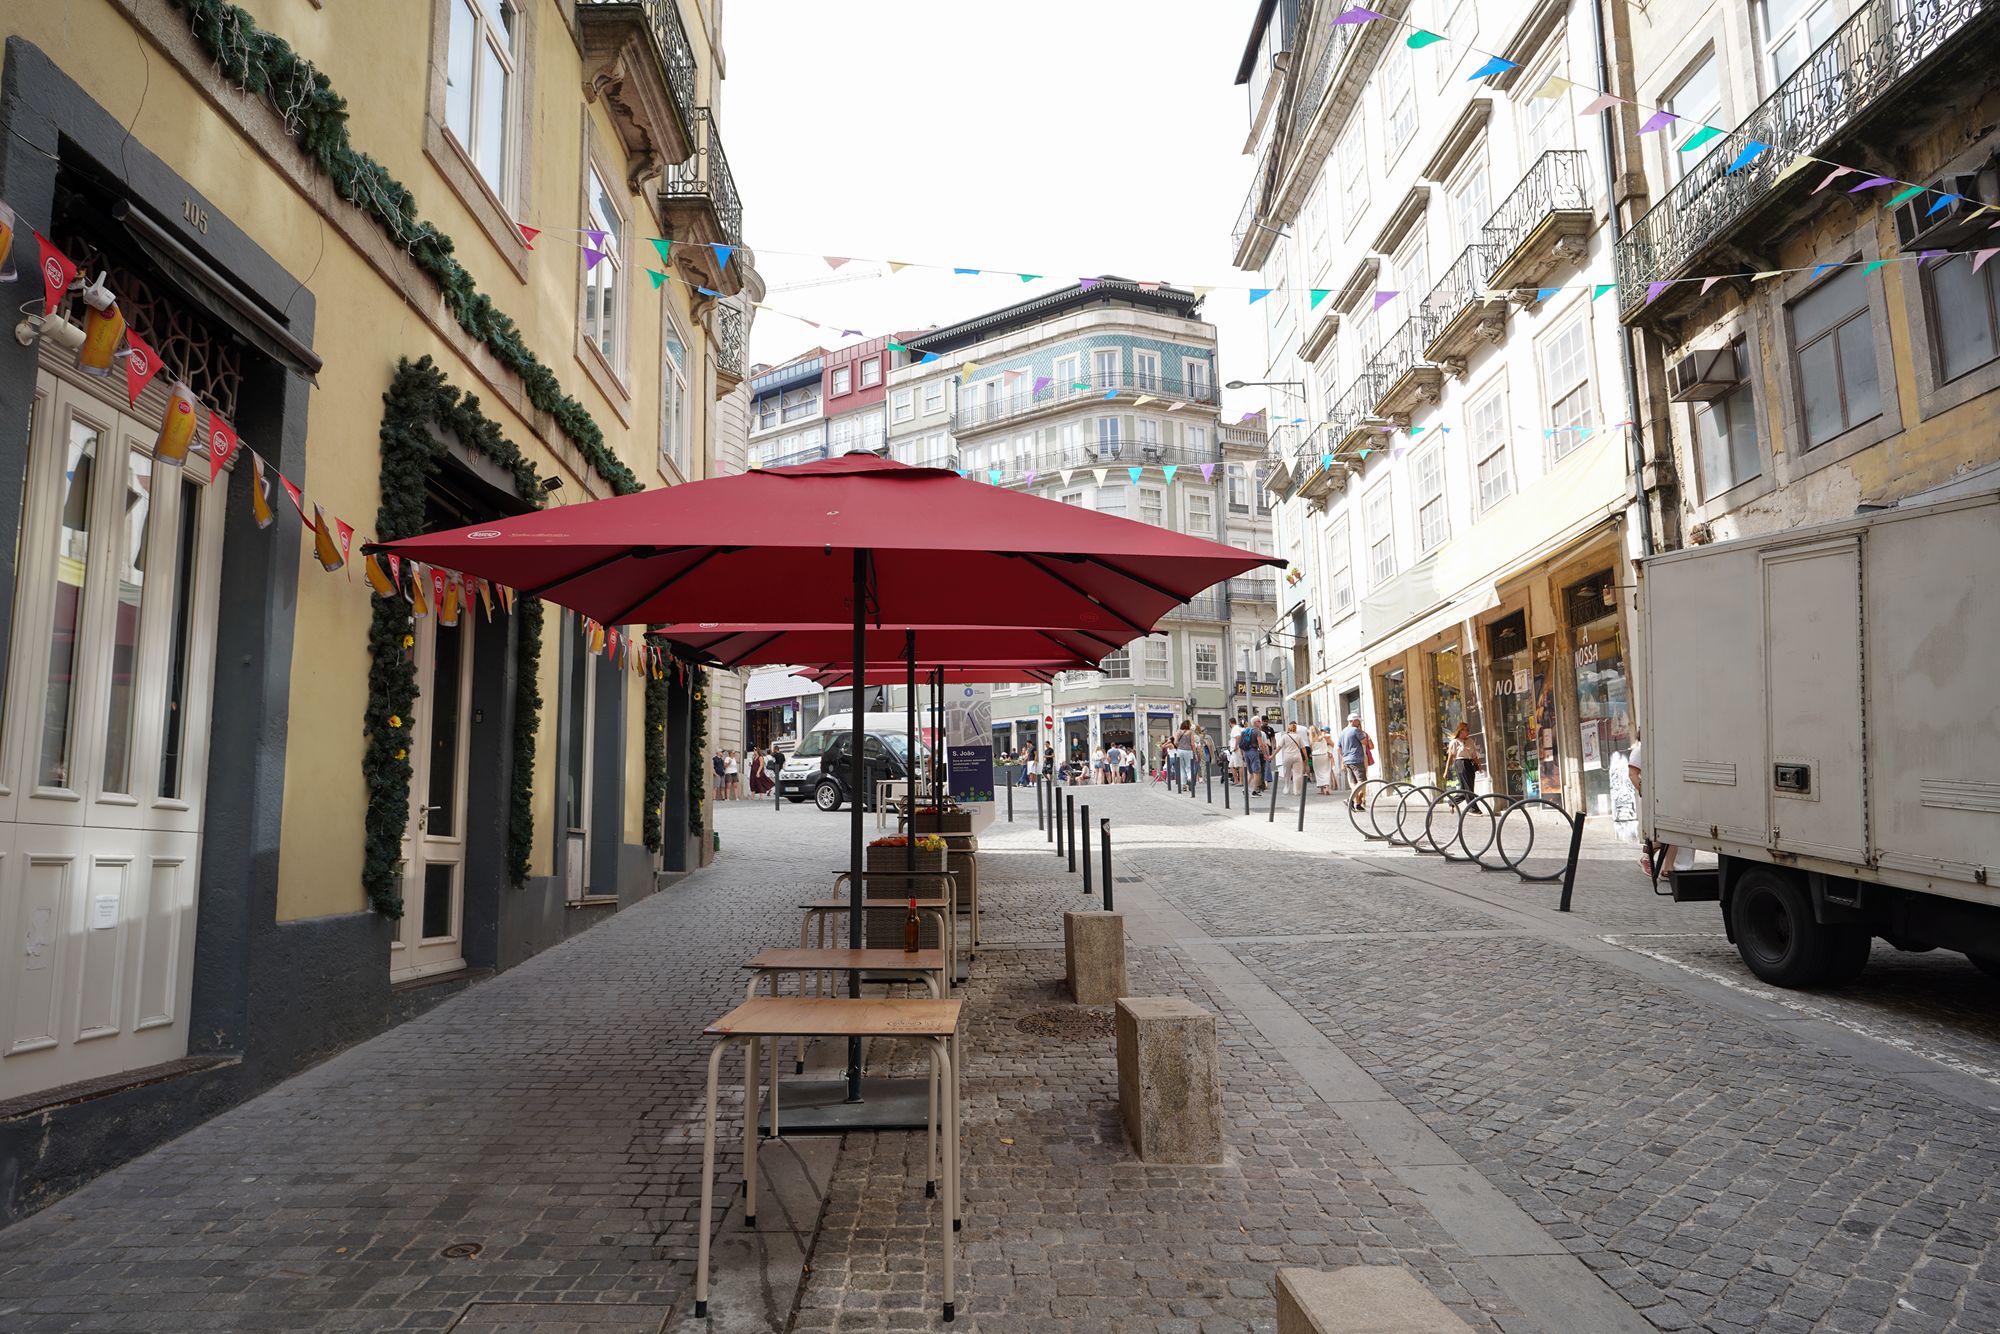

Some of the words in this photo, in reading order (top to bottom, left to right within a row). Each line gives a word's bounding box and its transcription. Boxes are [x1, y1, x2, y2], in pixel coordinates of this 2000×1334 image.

[182, 201, 208, 234] 105
[1575, 643, 1598, 668] NOSSA
[1238, 684, 1277, 694] PAELARIA
